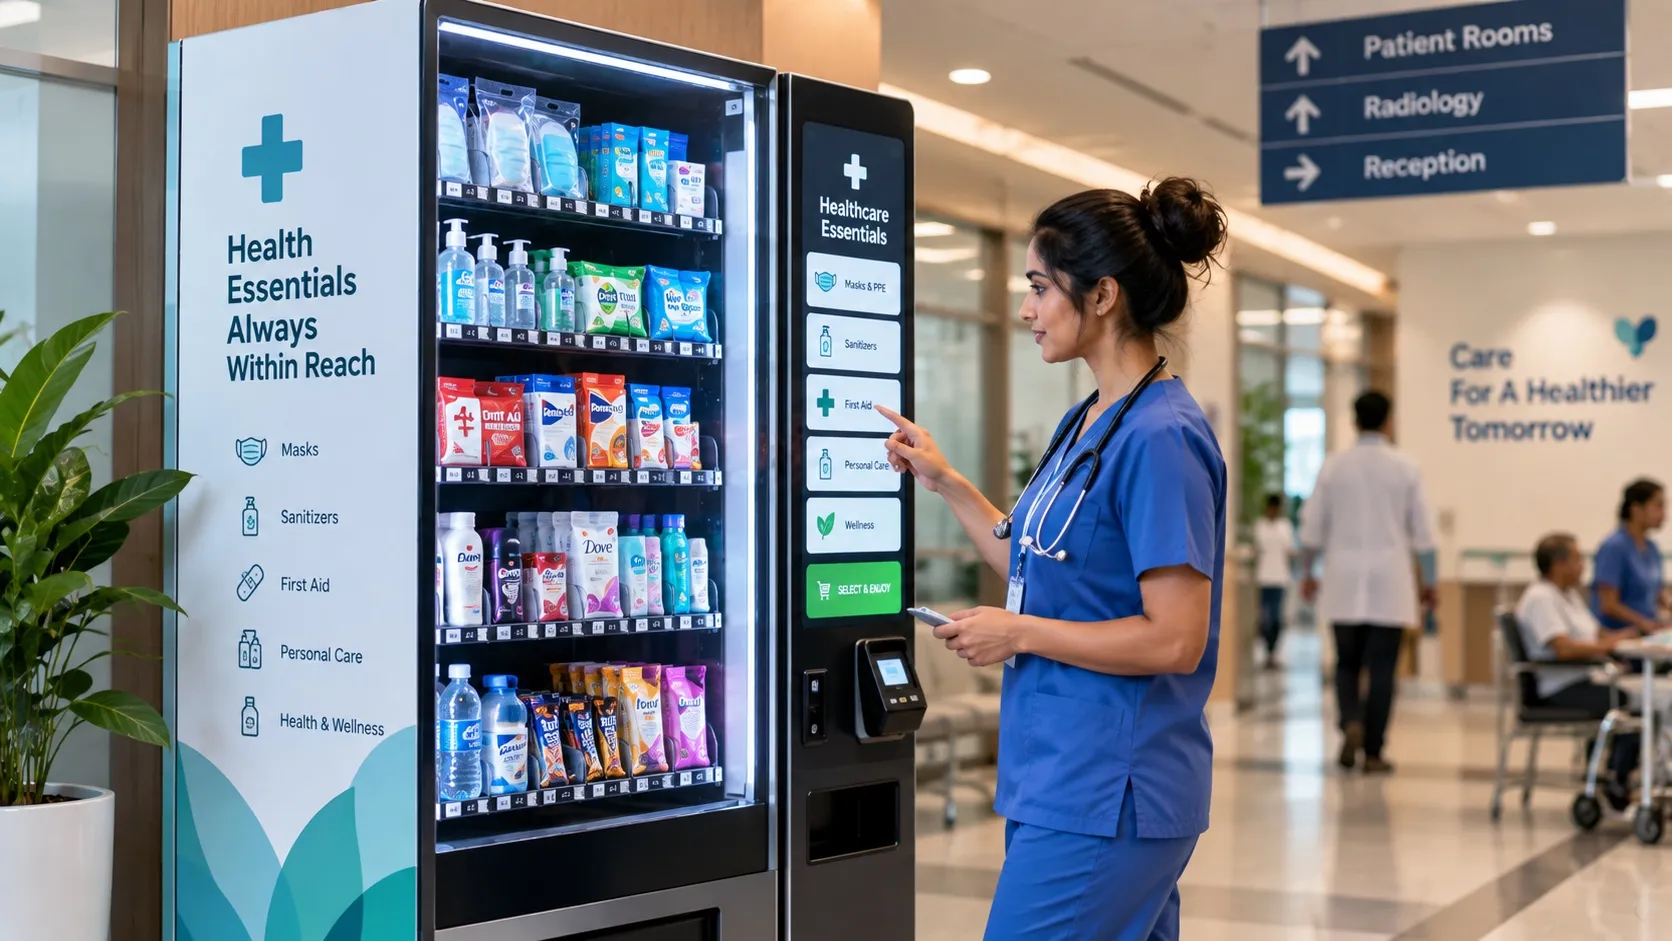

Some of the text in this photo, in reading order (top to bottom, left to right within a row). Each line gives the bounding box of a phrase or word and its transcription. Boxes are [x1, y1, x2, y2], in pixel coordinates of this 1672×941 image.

[1363, 22, 1553, 60] Patient Rooms
[1363, 89, 1483, 120] Radiology
[1363, 150, 1486, 181] Reception
[819, 196, 890, 223] Healthcare
[821, 219, 888, 245] Essentials
[227, 227, 313, 264] Health
[227, 265, 357, 304] Essentials
[844, 279, 887, 293] Masks & PPE
[226, 313, 318, 348] Always
[844, 339, 878, 351] Sanitizers
[1450, 343, 1513, 370] Care
[226, 347, 377, 382] Within Reach
[1450, 375, 1655, 406] For A Healthier
[844, 399, 873, 411] First Aid
[1450, 414, 1594, 442] Tomorrow
[281, 442, 319, 457] Masks
[844, 460, 890, 472] Personal Care
[281, 509, 339, 525] Sanitizers
[845, 520, 875, 531] Wellness
[584, 540, 613, 554] Dove
[280, 576, 330, 593] First Aid
[838, 584, 862, 596] SELECT
[280, 644, 363, 664] Personal Care
[280, 712, 385, 736] Health & Wellness
